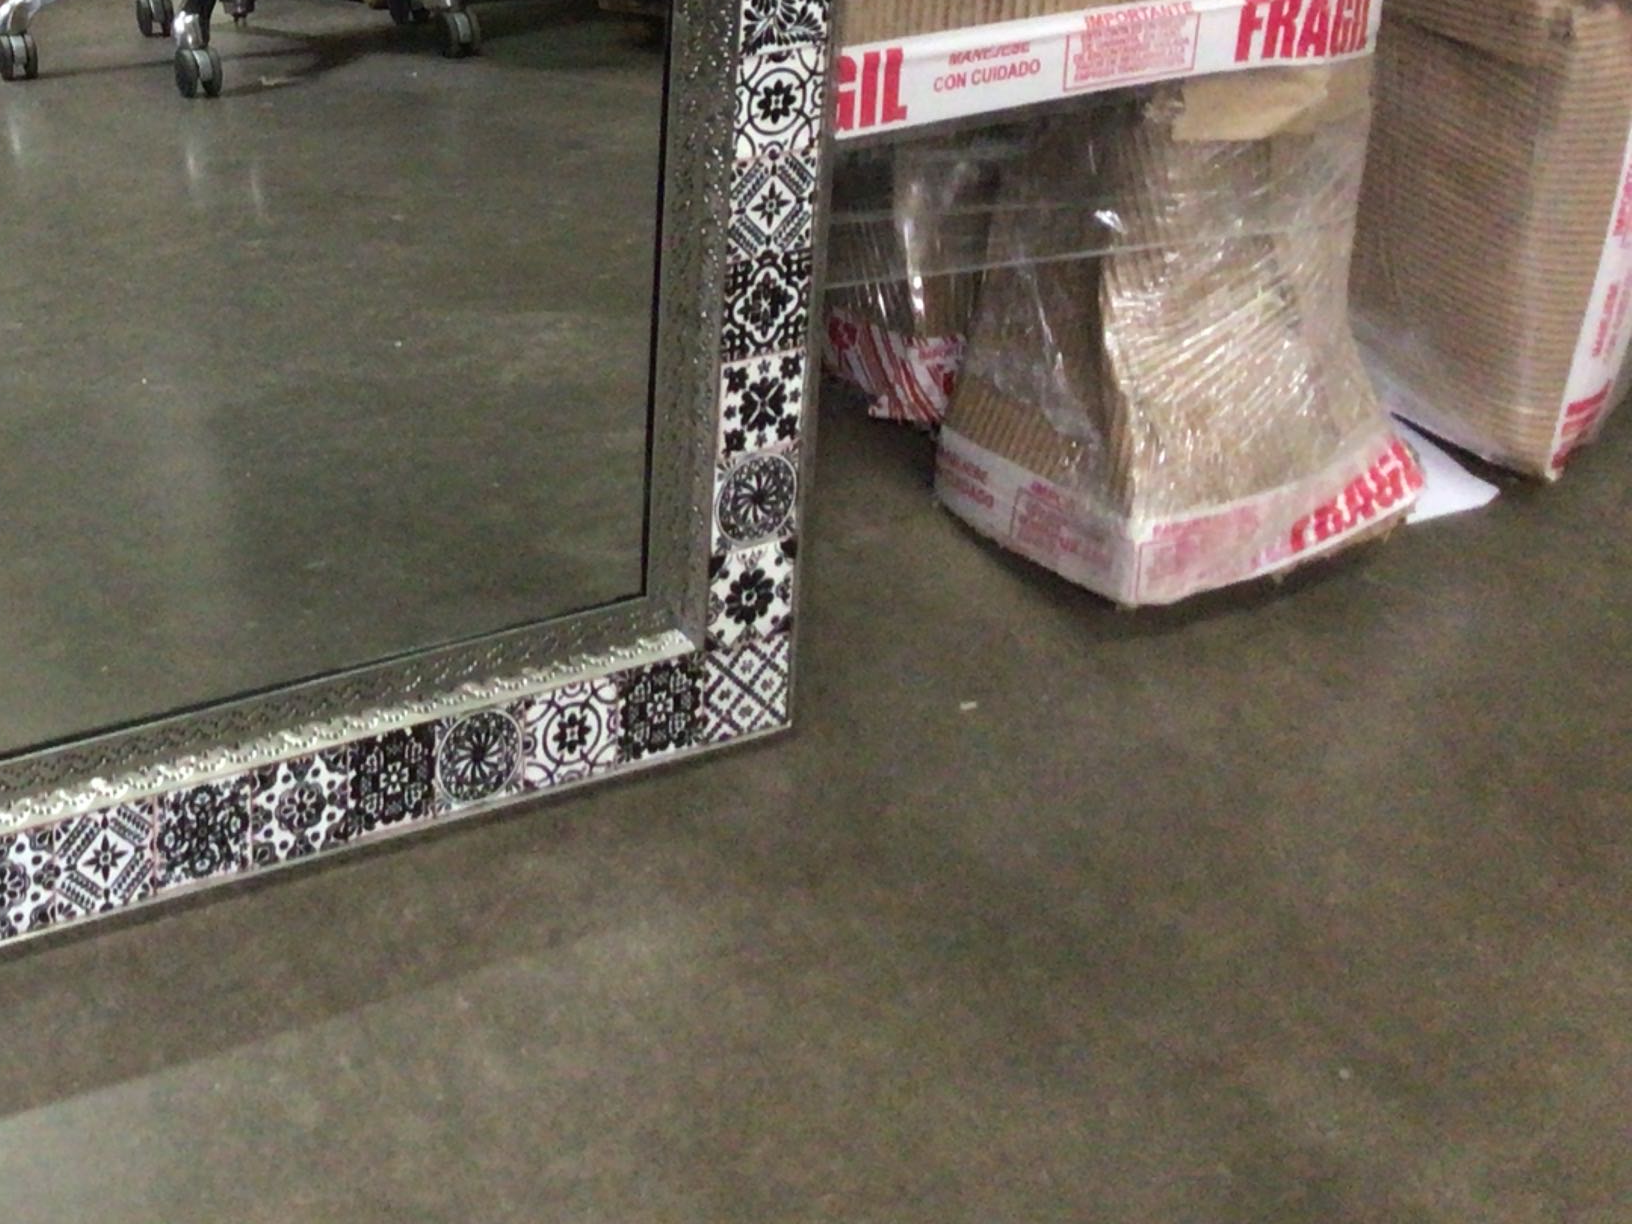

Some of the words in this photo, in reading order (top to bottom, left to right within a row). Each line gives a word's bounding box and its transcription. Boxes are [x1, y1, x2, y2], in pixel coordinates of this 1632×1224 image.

[1084, 1, 1192, 26] IMPORTANTE
[933, 74, 966, 92] CON
[971, 59, 1041, 86] CUIDADO
